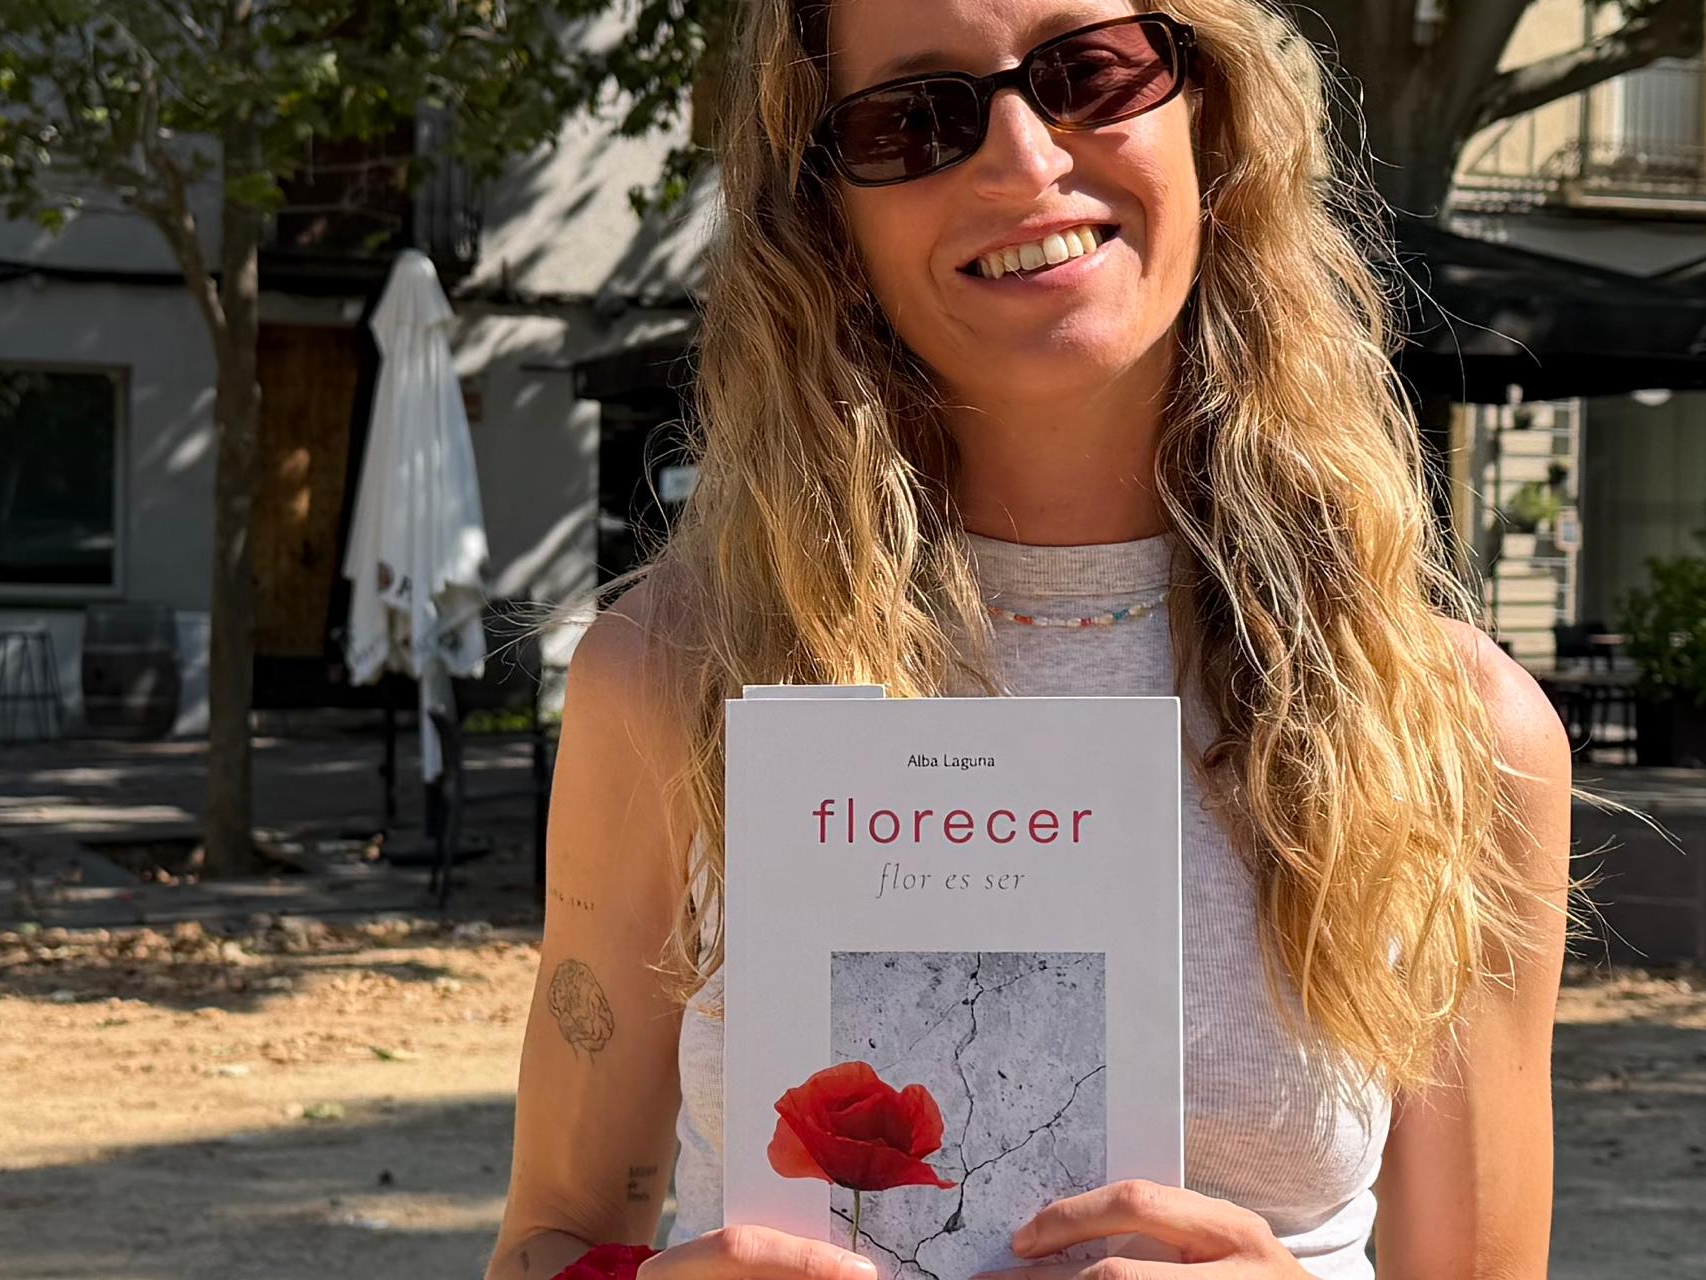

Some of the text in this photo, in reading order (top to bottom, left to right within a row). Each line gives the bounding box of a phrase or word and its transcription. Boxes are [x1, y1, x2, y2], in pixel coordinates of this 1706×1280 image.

[907, 754, 995, 771] Alba Laguna
[812, 797, 1093, 844] florecer
[876, 862, 1026, 899] flor es ser
